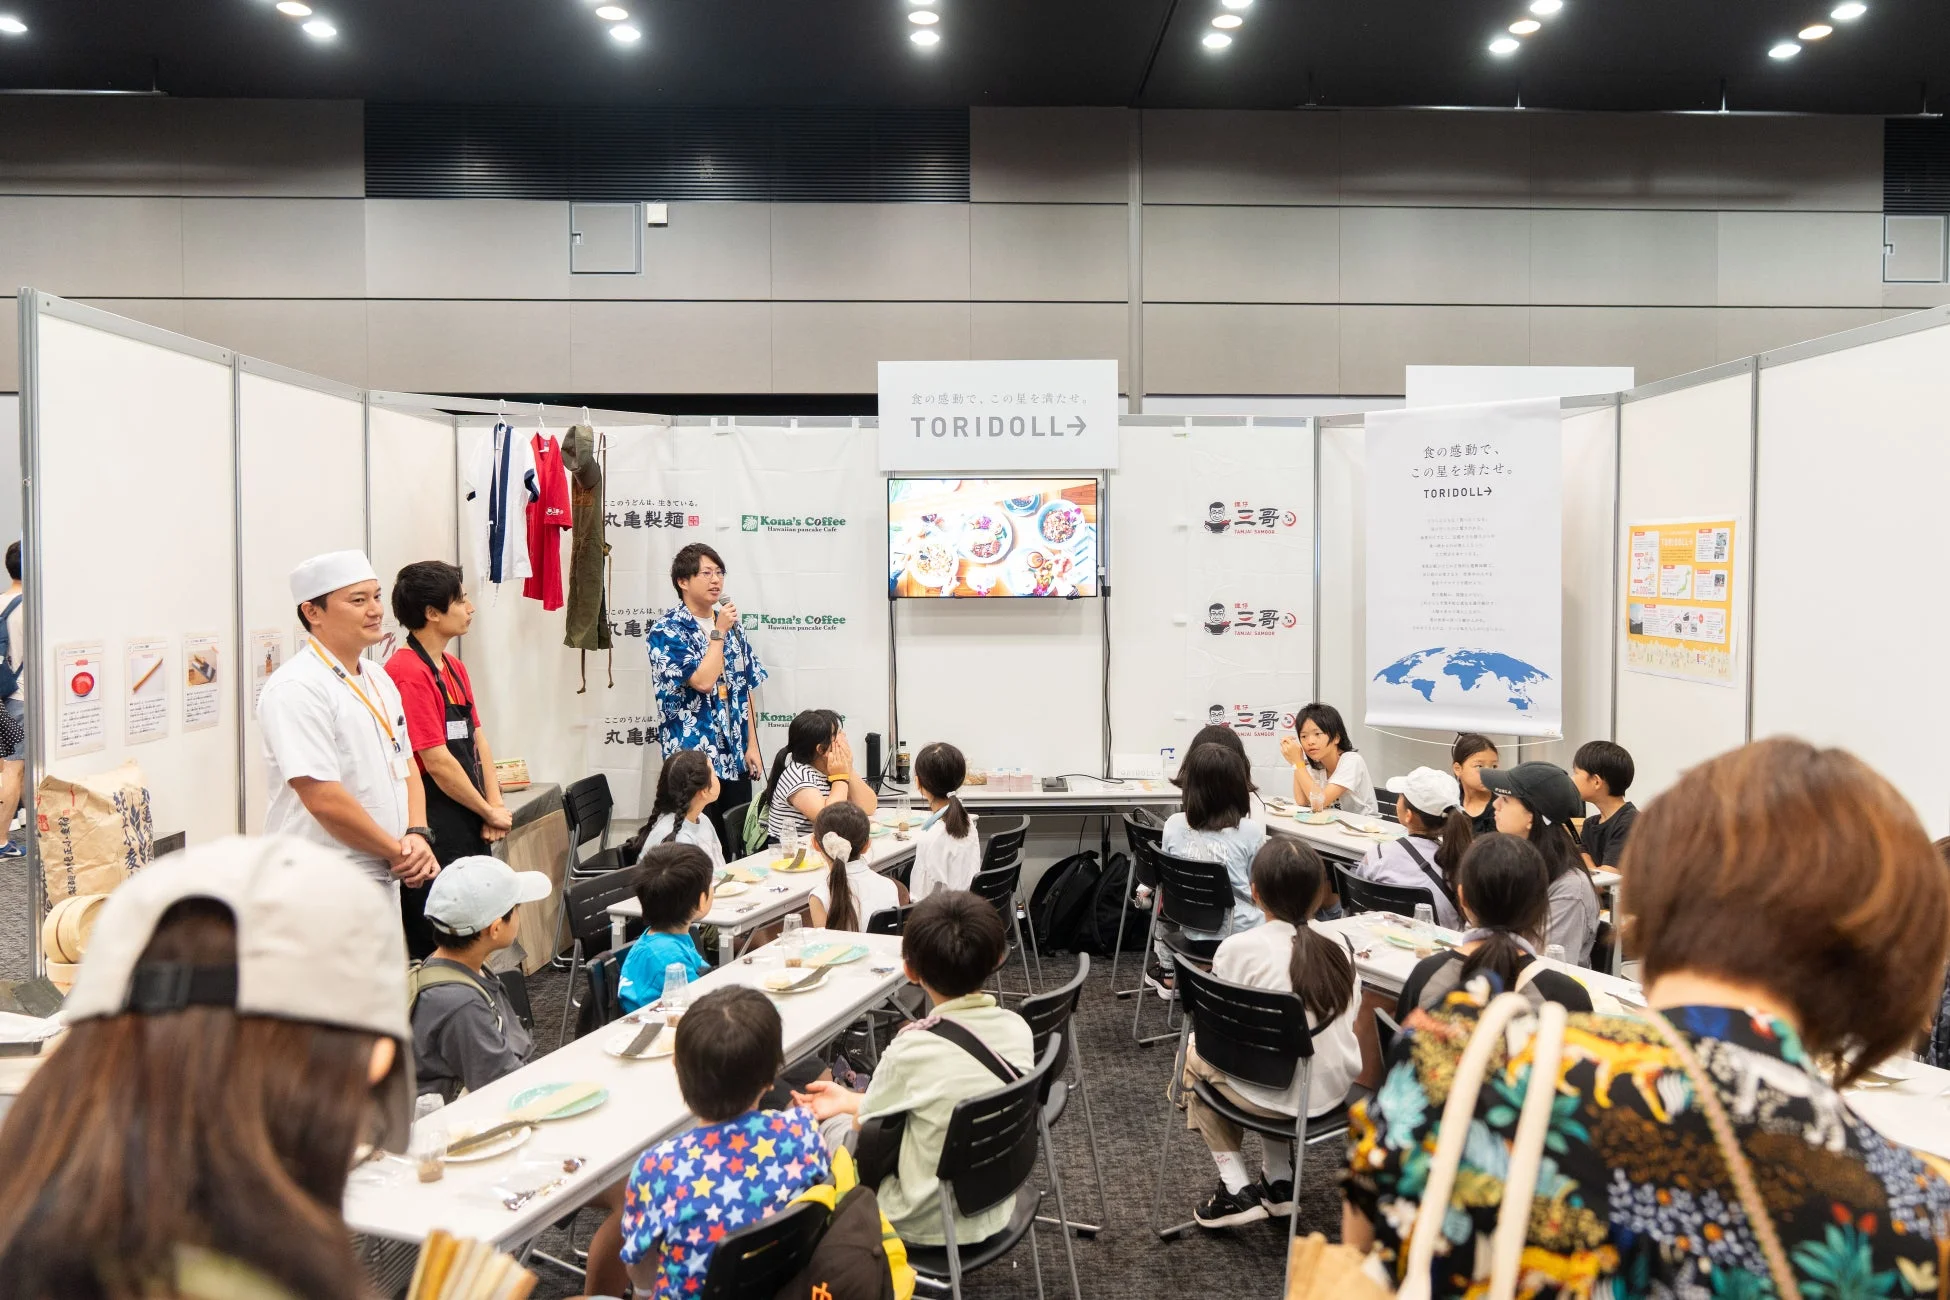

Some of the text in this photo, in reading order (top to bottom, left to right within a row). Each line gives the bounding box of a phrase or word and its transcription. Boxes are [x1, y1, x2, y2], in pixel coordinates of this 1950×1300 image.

[911, 392, 1087, 405] 食の感動で、この星を満たせ。
[910, 416, 1065, 437] TORIDOLL
[1424, 443, 1499, 459] 食の感動で、
[1411, 463, 1513, 478] この星を満たせ。
[1423, 486, 1484, 499] TORIDOLL
[604, 510, 684, 529] 丸亀製麺
[760, 515, 847, 526] Kona's Coffee
[1234, 508, 1280, 528] 三哥
[760, 614, 847, 624] Kona's Coffee
[1234, 610, 1280, 629] 三哥
[760, 712, 797, 722] Kona'
[1234, 711, 1280, 731] 三哥
